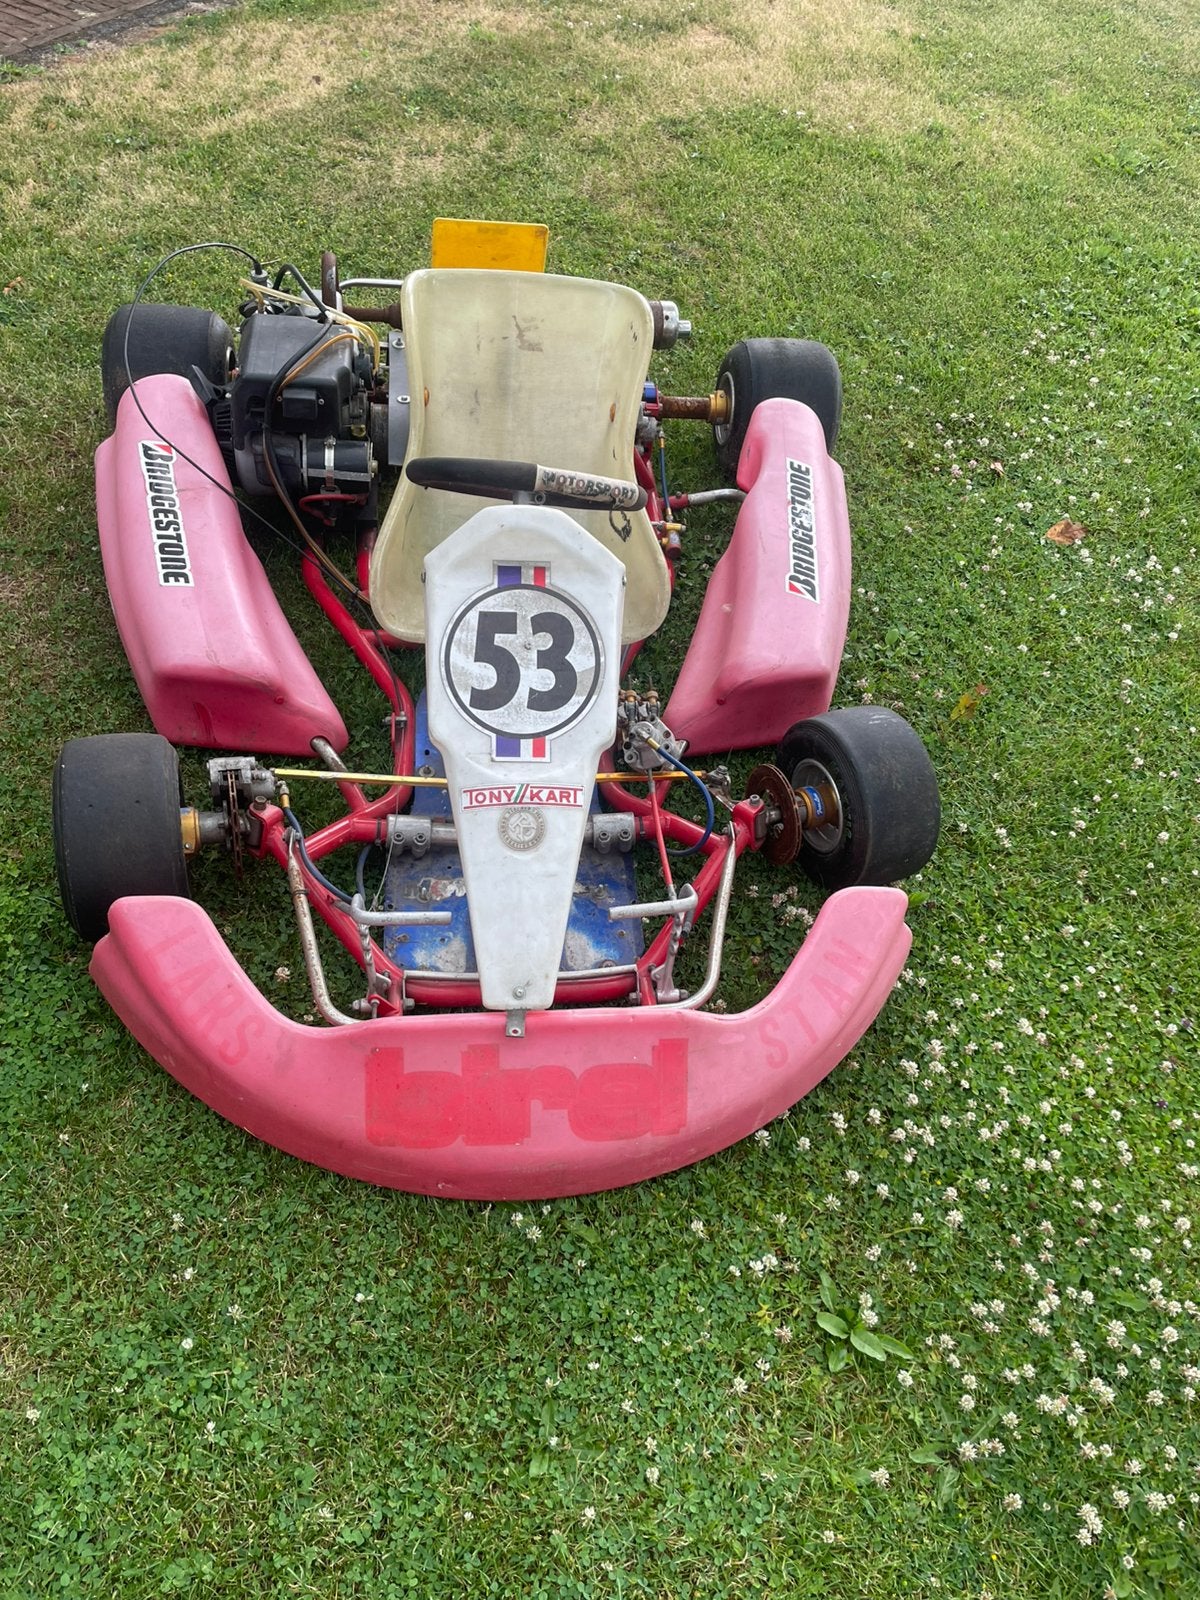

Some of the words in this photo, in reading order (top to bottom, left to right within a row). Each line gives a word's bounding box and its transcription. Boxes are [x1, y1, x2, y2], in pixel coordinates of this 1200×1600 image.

[142, 442, 190, 584] BRIDGESTONE
[542, 470, 636, 500] MOTORSPORT
[789, 460, 817, 601] BRIDGESTONE
[469, 610, 578, 712] 53
[464, 786, 516, 805] TONY
[529, 786, 582, 804] KART
